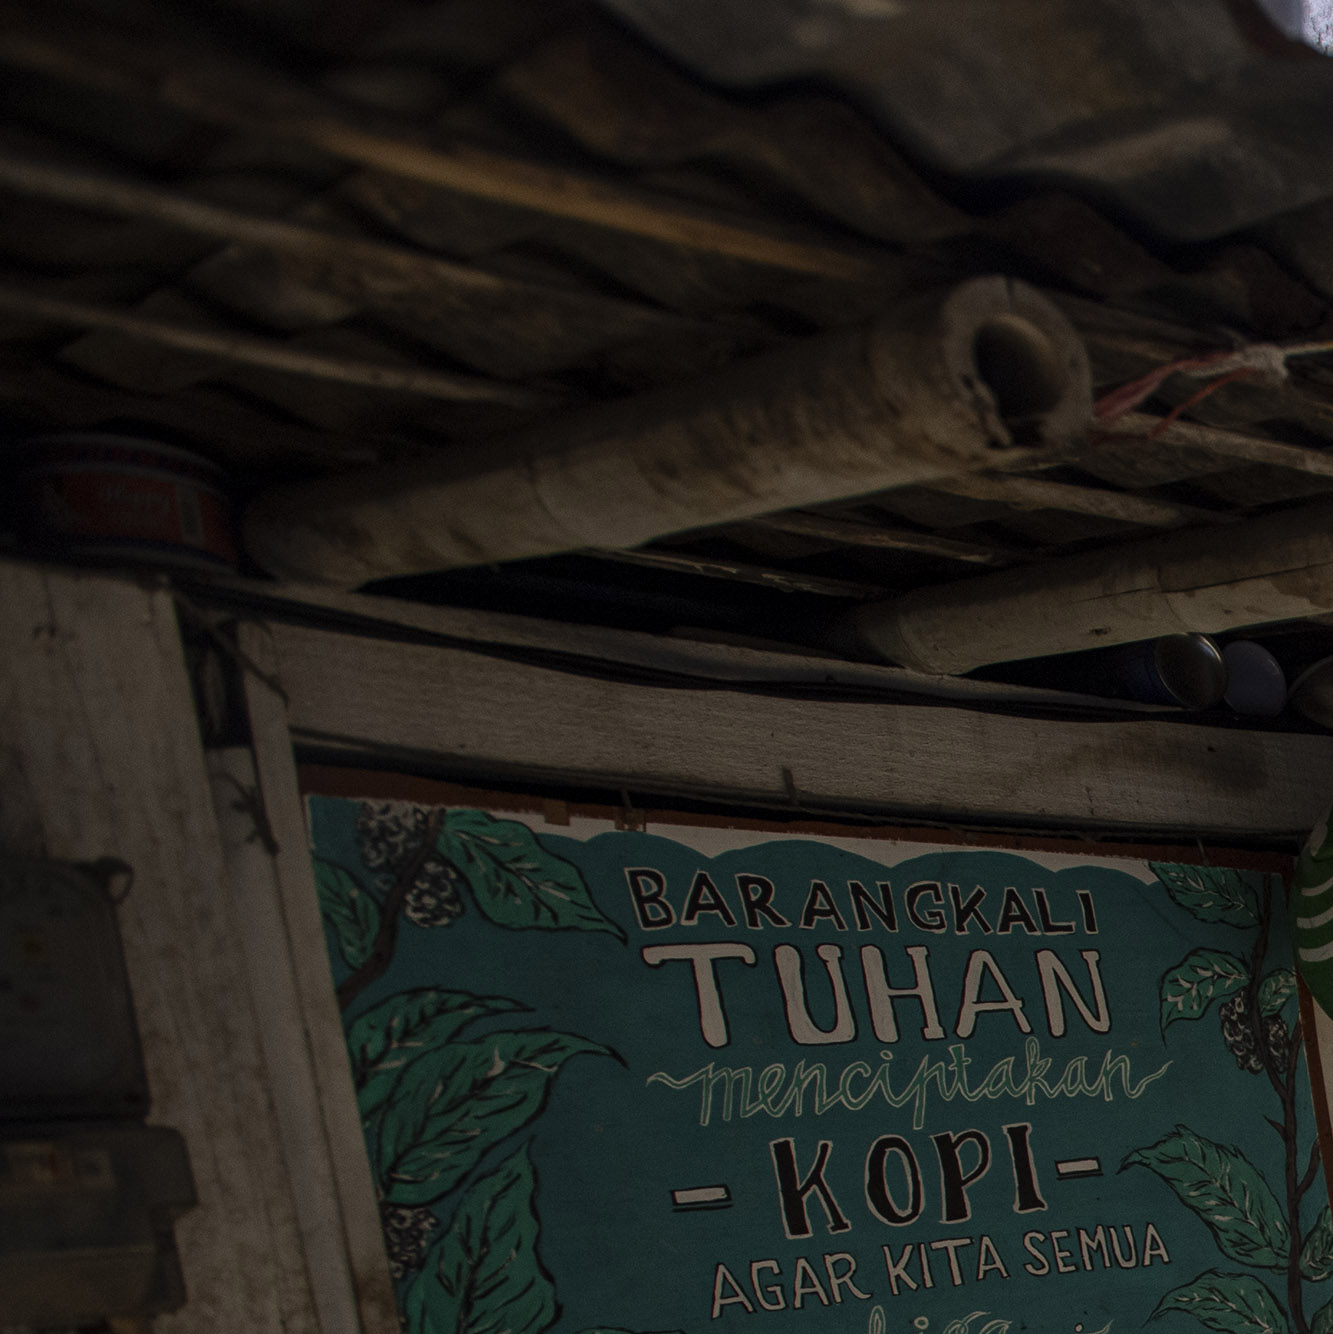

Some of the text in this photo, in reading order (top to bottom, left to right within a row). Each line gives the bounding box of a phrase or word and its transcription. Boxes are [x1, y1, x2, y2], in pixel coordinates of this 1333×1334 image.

[624, 867, 1099, 936] BARANGKALI
[641, 942, 1111, 1047] TUHAN
[646, 1037, 1173, 1130] menciptakan
[769, 1122, 1048, 1240] KOPI
[710, 1223, 1171, 1319] AGAR KITA SEMUA
